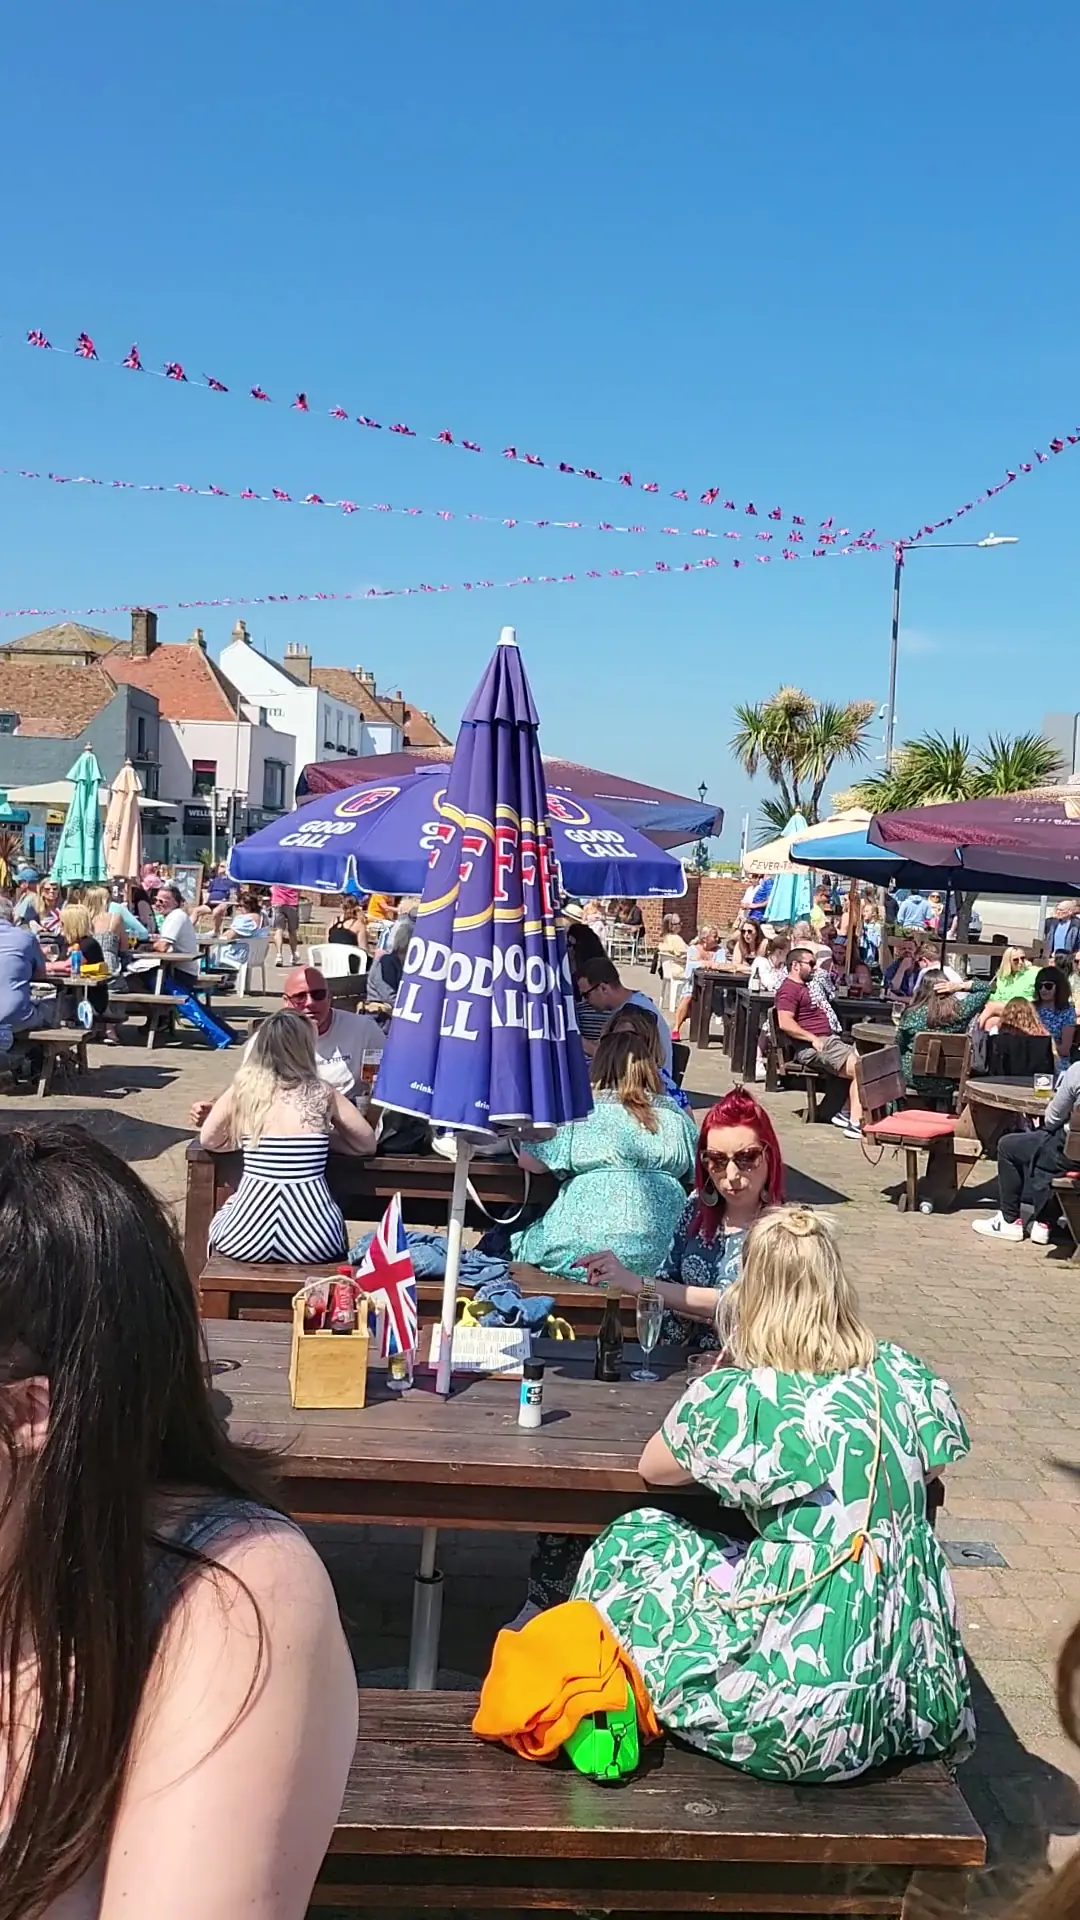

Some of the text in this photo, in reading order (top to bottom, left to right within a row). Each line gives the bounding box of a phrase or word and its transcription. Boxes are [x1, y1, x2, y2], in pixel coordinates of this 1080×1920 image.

[298, 820, 357, 834] GOOD
[278, 833, 332, 848] CALL
[564, 829, 625, 843] GOOD
[580, 844, 637, 857] CALL
